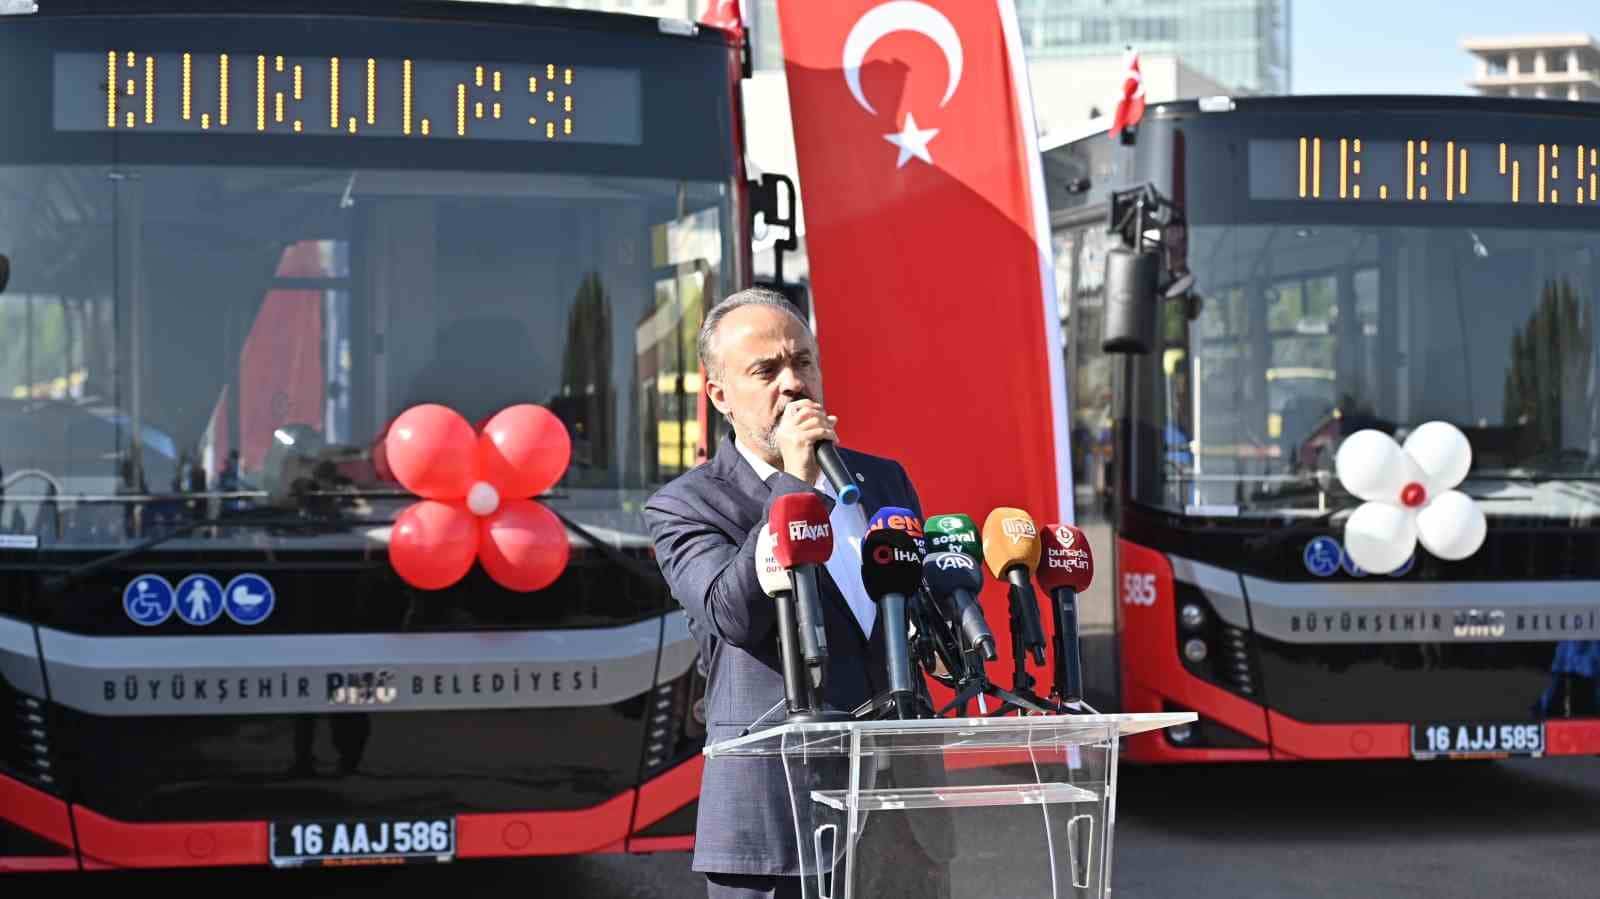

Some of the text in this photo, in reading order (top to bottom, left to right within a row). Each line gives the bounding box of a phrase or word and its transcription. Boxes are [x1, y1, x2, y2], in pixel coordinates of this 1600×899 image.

[789, 523, 829, 541] HAYAT
[932, 530, 976, 546] sosyal
[1048, 547, 1089, 559] bursada
[1048, 557, 1089, 573] bugün
[1123, 573, 1157, 606] 585
[1290, 606, 1441, 633] BÜYÜKŞEHİR
[103, 671, 311, 704] BÜYÜKŞEHİR
[411, 666, 599, 695] BELEDİYESİ
[1426, 724, 1540, 751] 16 AJJ 585
[291, 820, 448, 855] 16 AAJ 586
